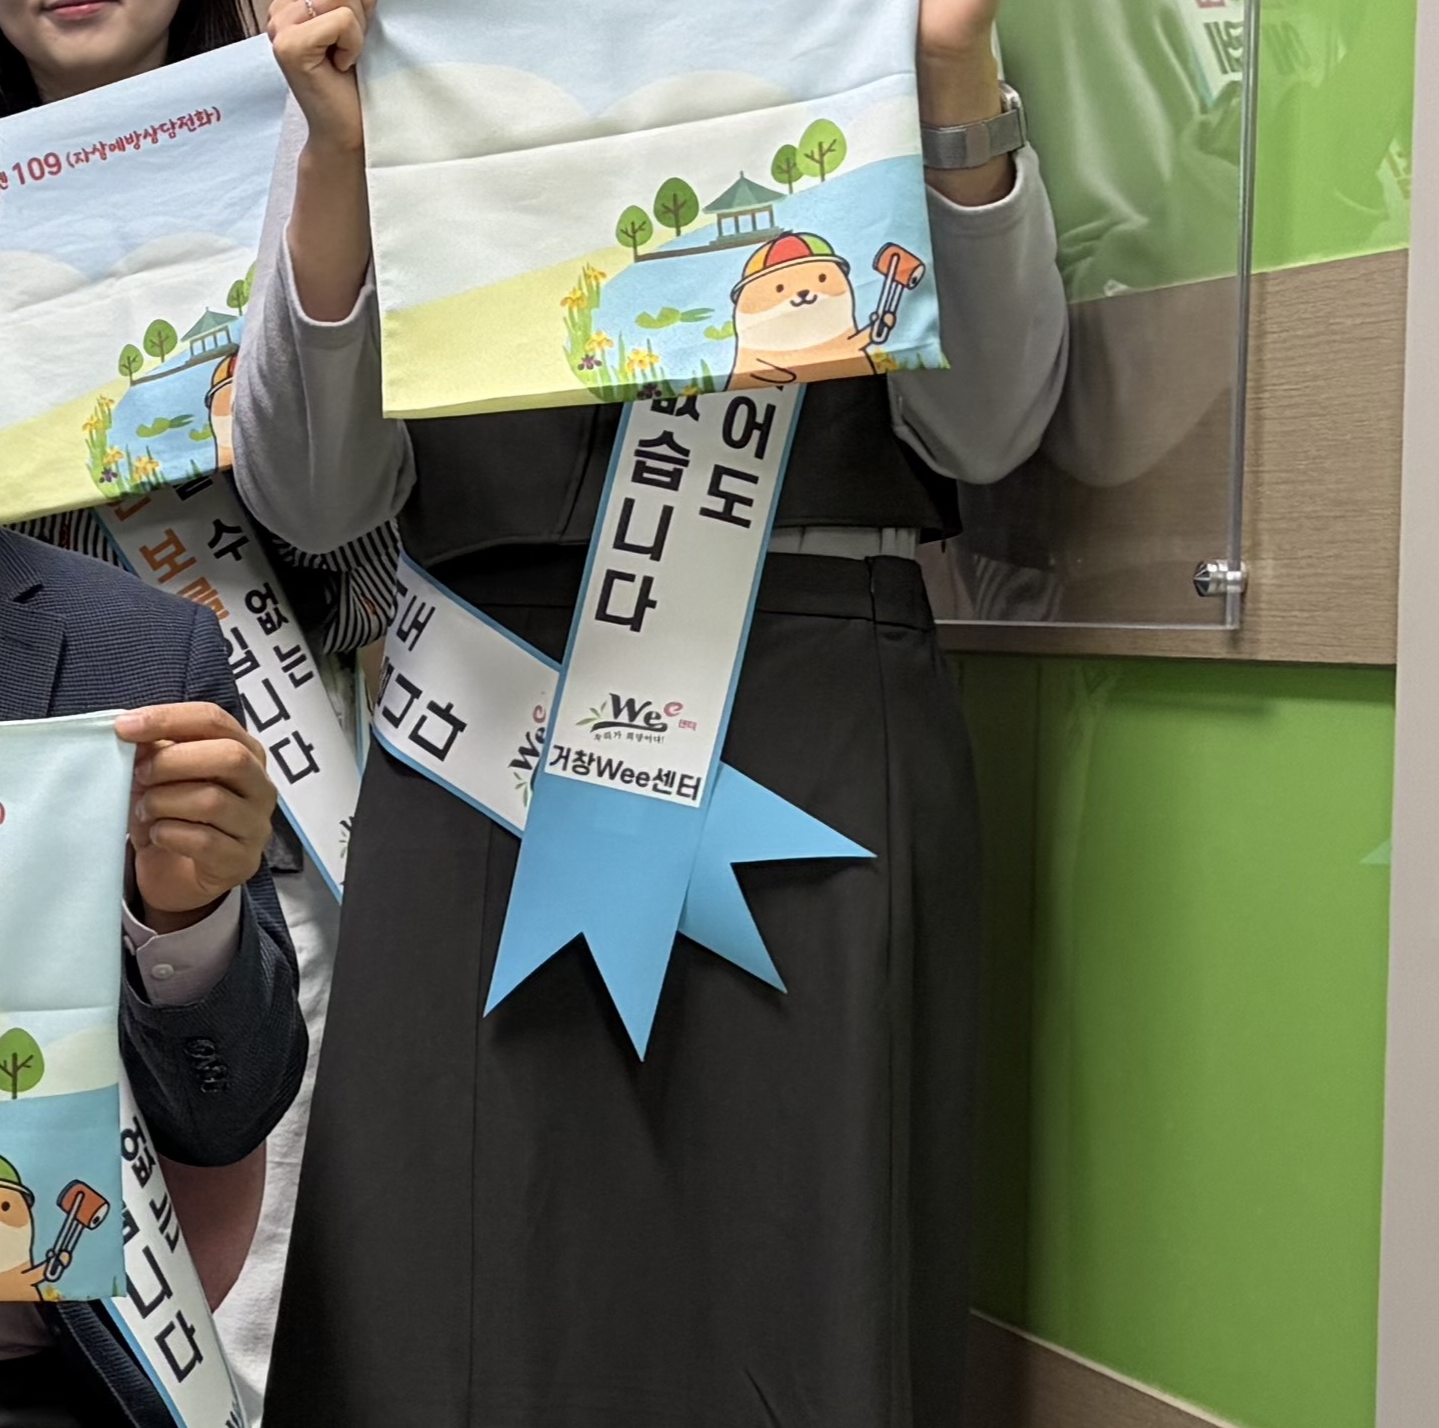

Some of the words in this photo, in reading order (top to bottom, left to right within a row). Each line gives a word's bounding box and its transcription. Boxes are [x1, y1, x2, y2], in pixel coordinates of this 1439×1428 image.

[12, 152, 63, 186] 109
[699, 392, 778, 529] 어도
[380, 670, 468, 762] 니다
[608, 692, 684, 733] Wee
[548, 743, 703, 801] 거창Wee센터
